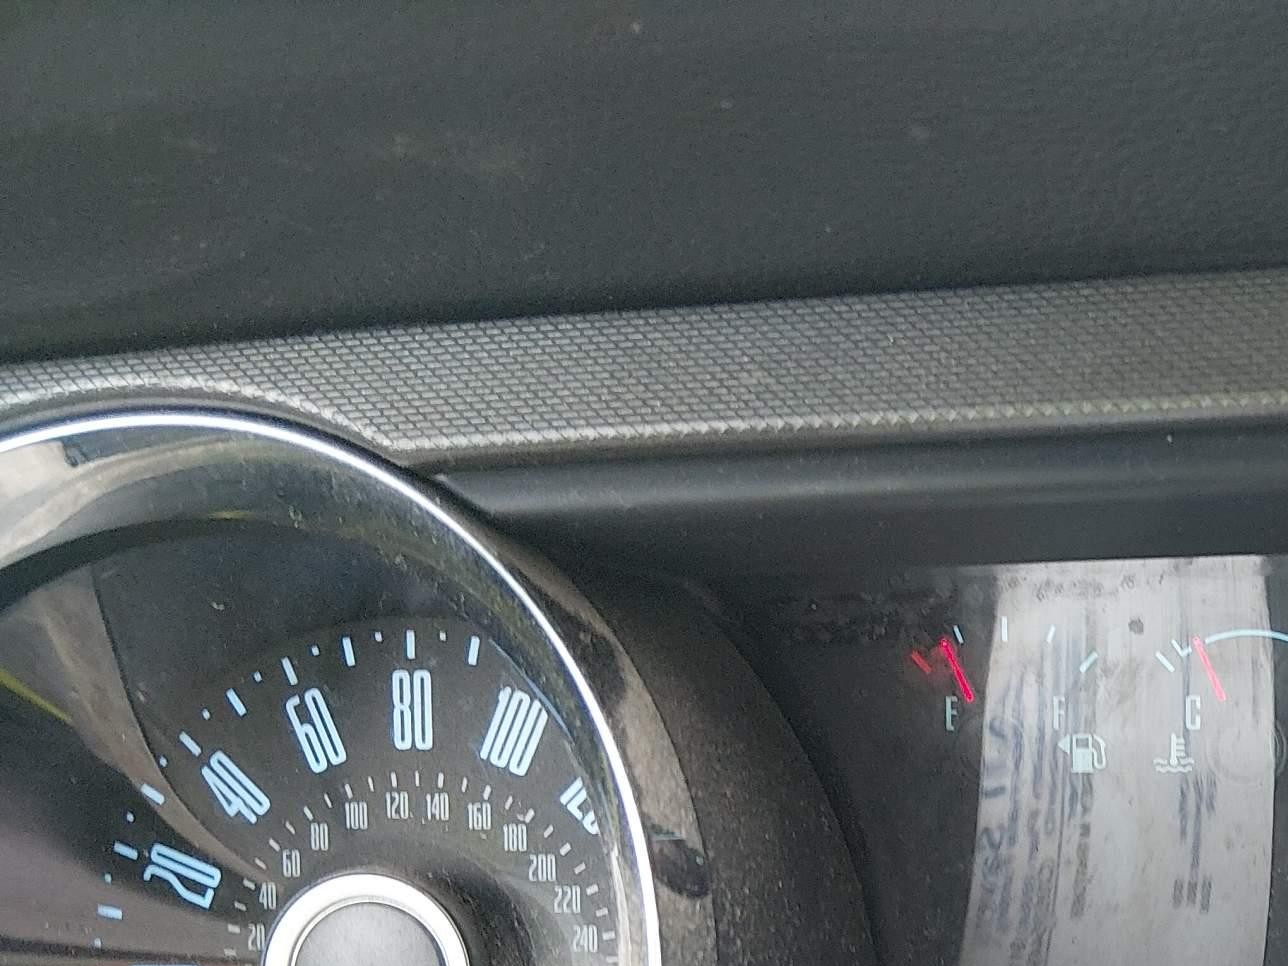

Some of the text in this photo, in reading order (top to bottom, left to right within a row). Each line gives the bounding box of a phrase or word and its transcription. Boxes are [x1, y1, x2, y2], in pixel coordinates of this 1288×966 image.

[392, 670, 432, 750] 80
[1052, 695, 1066, 731] F
[1185, 694, 1201, 731] C
[287, 689, 346, 773] 60
[481, 687, 547, 775] 100
[202, 752, 270, 822] 40
[344, 801, 368, 830] 100
[385, 791, 409, 819] 120
[425, 792, 449, 822] 140
[467, 802, 492, 830] 160
[310, 822, 330, 851] 80
[502, 823, 528, 852] 180
[144, 843, 221, 907] 20
[282, 849, 301, 878] 60
[528, 854, 557, 882] 200
[258, 882, 277, 911] 40
[553, 885, 582, 914] 220
[247, 923, 266, 951] 20
[573, 924, 599, 953] 240
